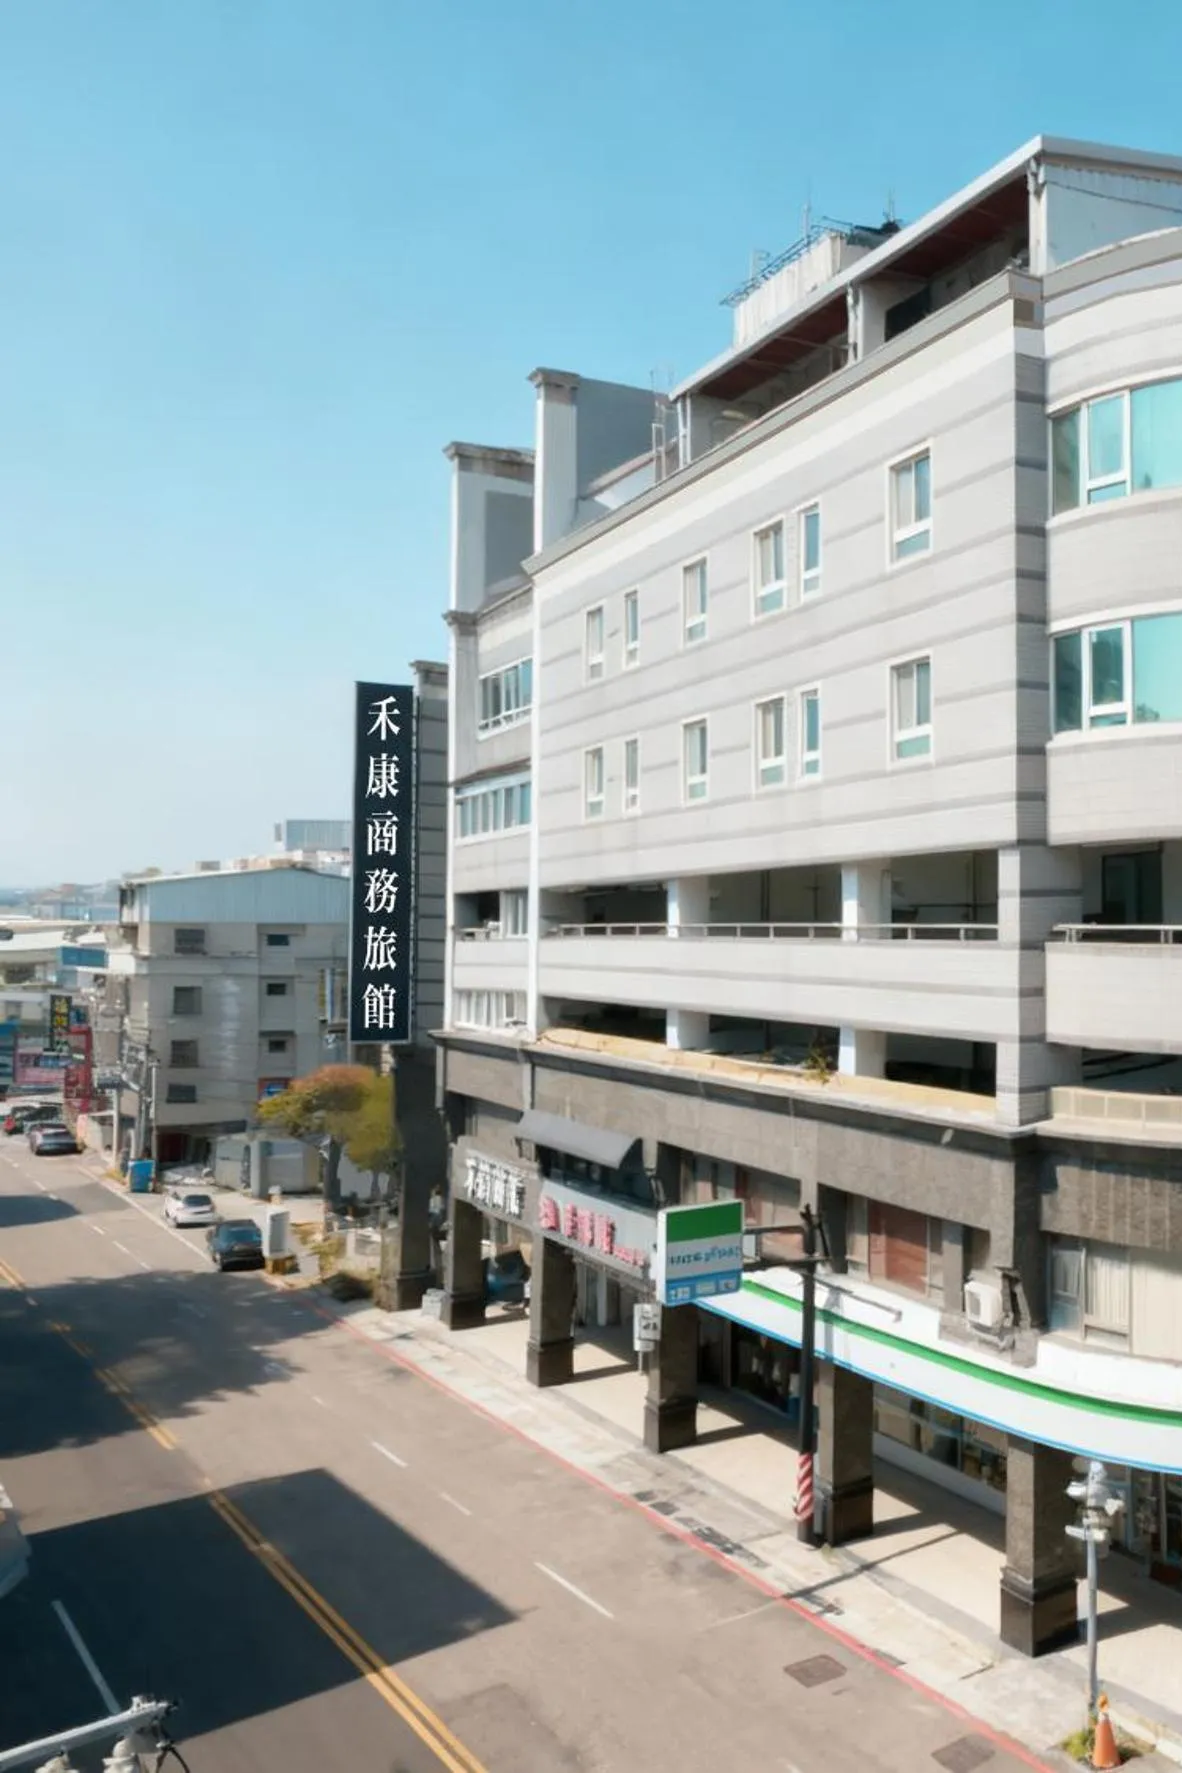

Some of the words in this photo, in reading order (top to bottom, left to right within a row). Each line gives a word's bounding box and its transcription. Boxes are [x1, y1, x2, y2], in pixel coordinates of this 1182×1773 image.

[362, 695, 401, 1030] 禾康商務旅館
